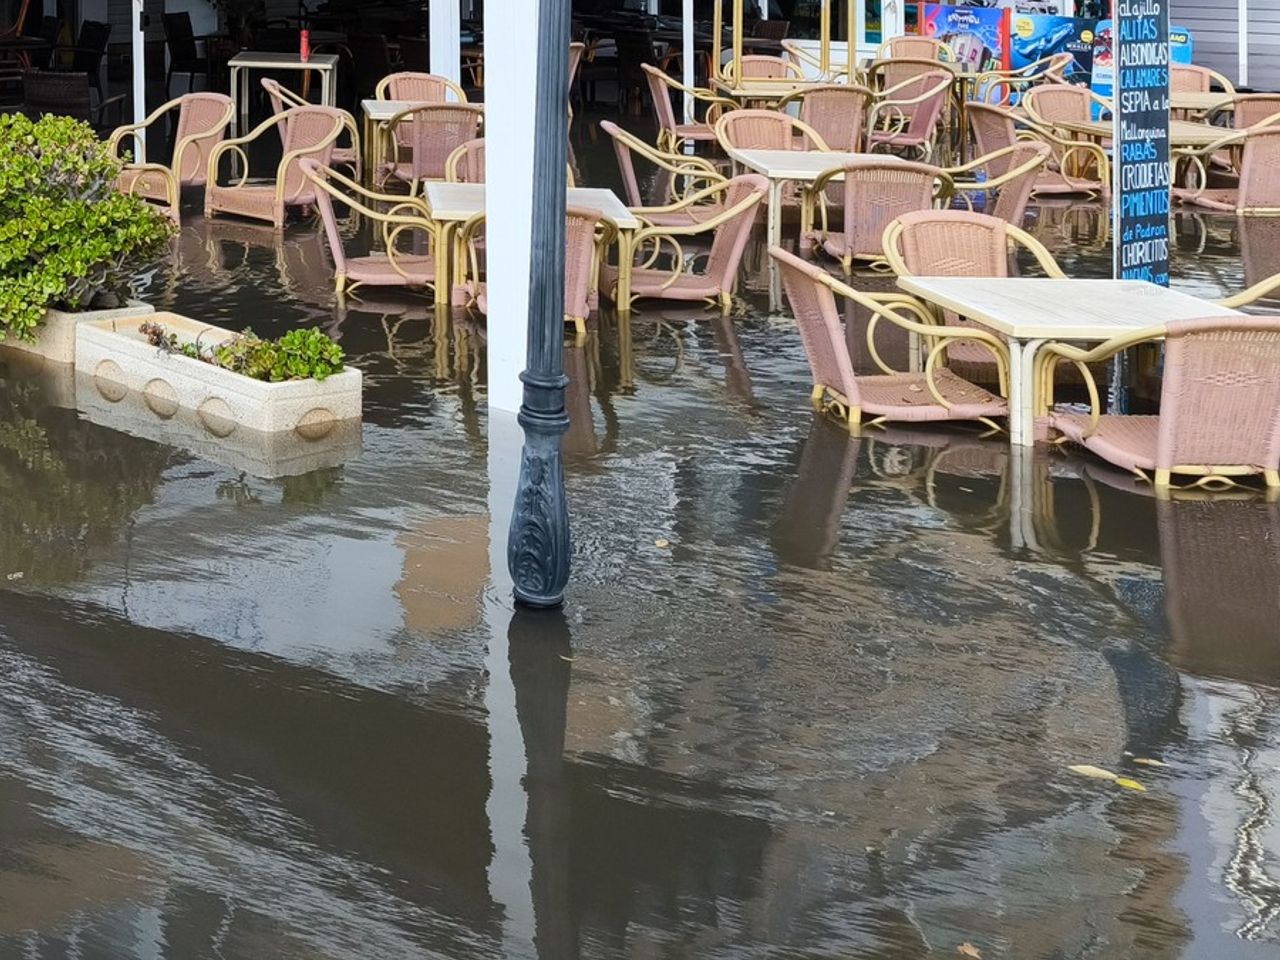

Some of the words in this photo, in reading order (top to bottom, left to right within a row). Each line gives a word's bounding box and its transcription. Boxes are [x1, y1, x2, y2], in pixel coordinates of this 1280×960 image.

[1120, 19, 1157, 40] ALITAS
[1121, 67, 1168, 90] CALAMARES
[1122, 91, 1151, 114] SEPIA
[1122, 141, 1158, 164] RABAS
[1122, 161, 1169, 191] CROQUETAS
